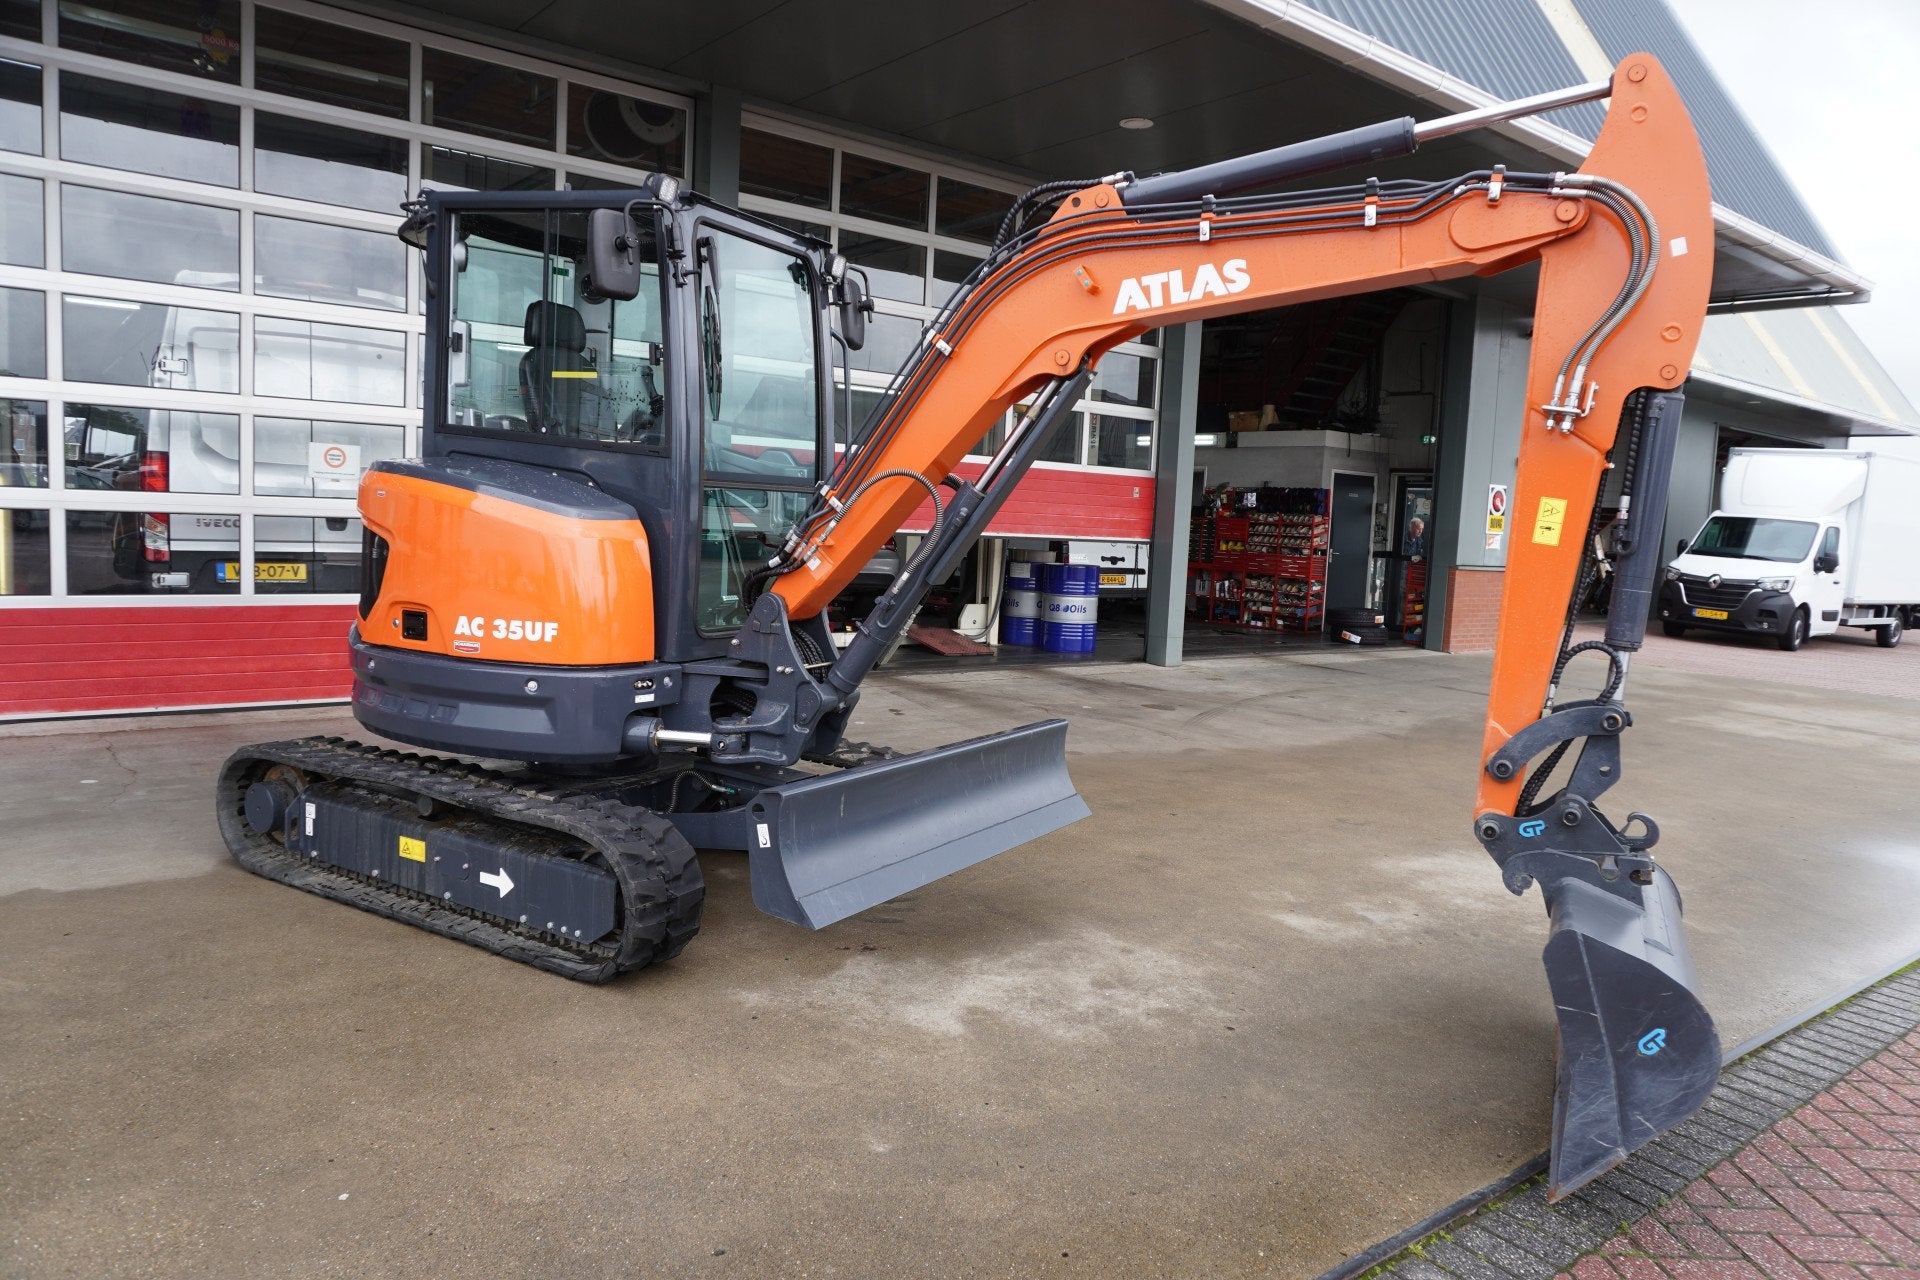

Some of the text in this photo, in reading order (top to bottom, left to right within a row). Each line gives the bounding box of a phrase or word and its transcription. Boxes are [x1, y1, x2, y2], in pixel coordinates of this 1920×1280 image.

[1113, 258, 1251, 315] ATLAS
[232, 565, 300, 578] VB-07-V
[1049, 603, 1060, 613] Q8
[1069, 604, 1087, 614] Oils
[454, 615, 559, 642] AC 35UF
